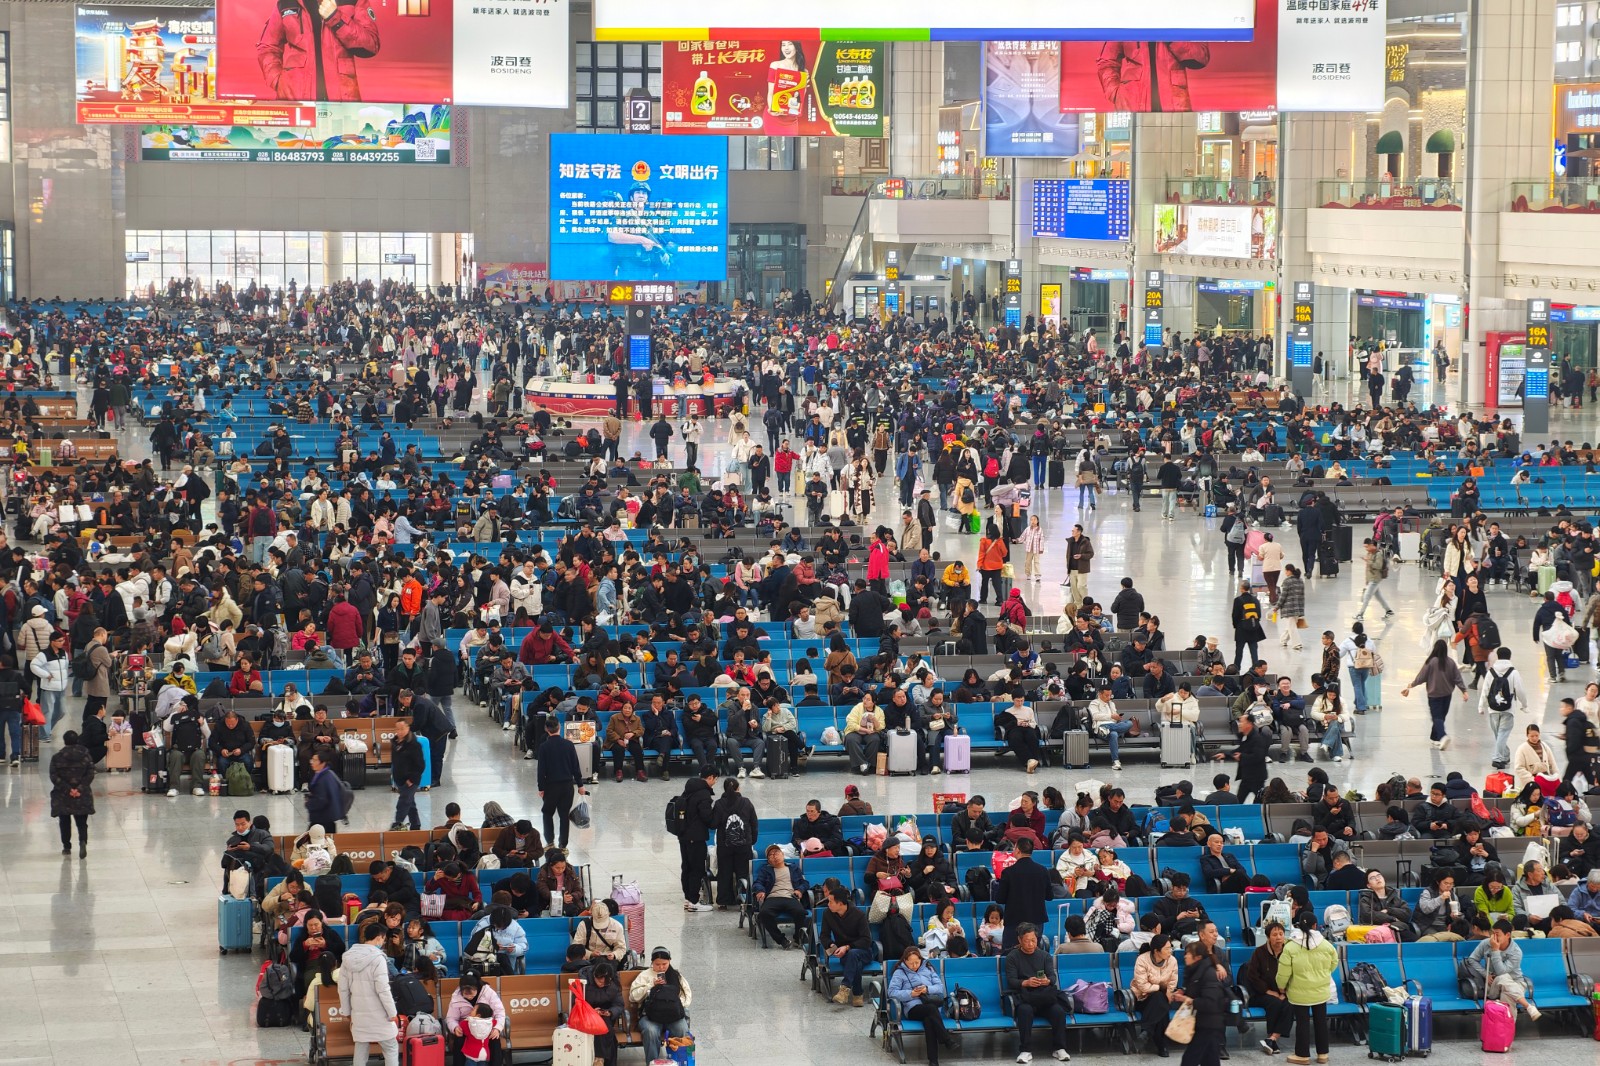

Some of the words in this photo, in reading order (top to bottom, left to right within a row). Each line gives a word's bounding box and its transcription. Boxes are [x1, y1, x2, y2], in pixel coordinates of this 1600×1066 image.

[473, 7, 510, 15] 新年送家人
[513, 8, 550, 16] 就选波司登
[1287, 0, 1379, 12] 温暖中国家庭49年
[168, 19, 214, 34] 海尔空调
[678, 40, 740, 52] 回家看爸妈
[691, 49, 765, 66] 带上长寿花
[836, 49, 873, 60] 长寿花
[490, 55, 532, 67] 波司登
[836, 65, 873, 74] 甘油二酯油
[1312, 63, 1351, 74] 波司登
[274, 151, 325, 162] 86483793
[349, 152, 400, 162] 86439255
[559, 163, 622, 179] 知法守法
[659, 164, 719, 180] 文明出行
[1295, 306, 1311, 314] 18A
[1295, 314, 1311, 322] 19A
[1528, 327, 1547, 336] 16A
[1528, 337, 1547, 345] 17A
